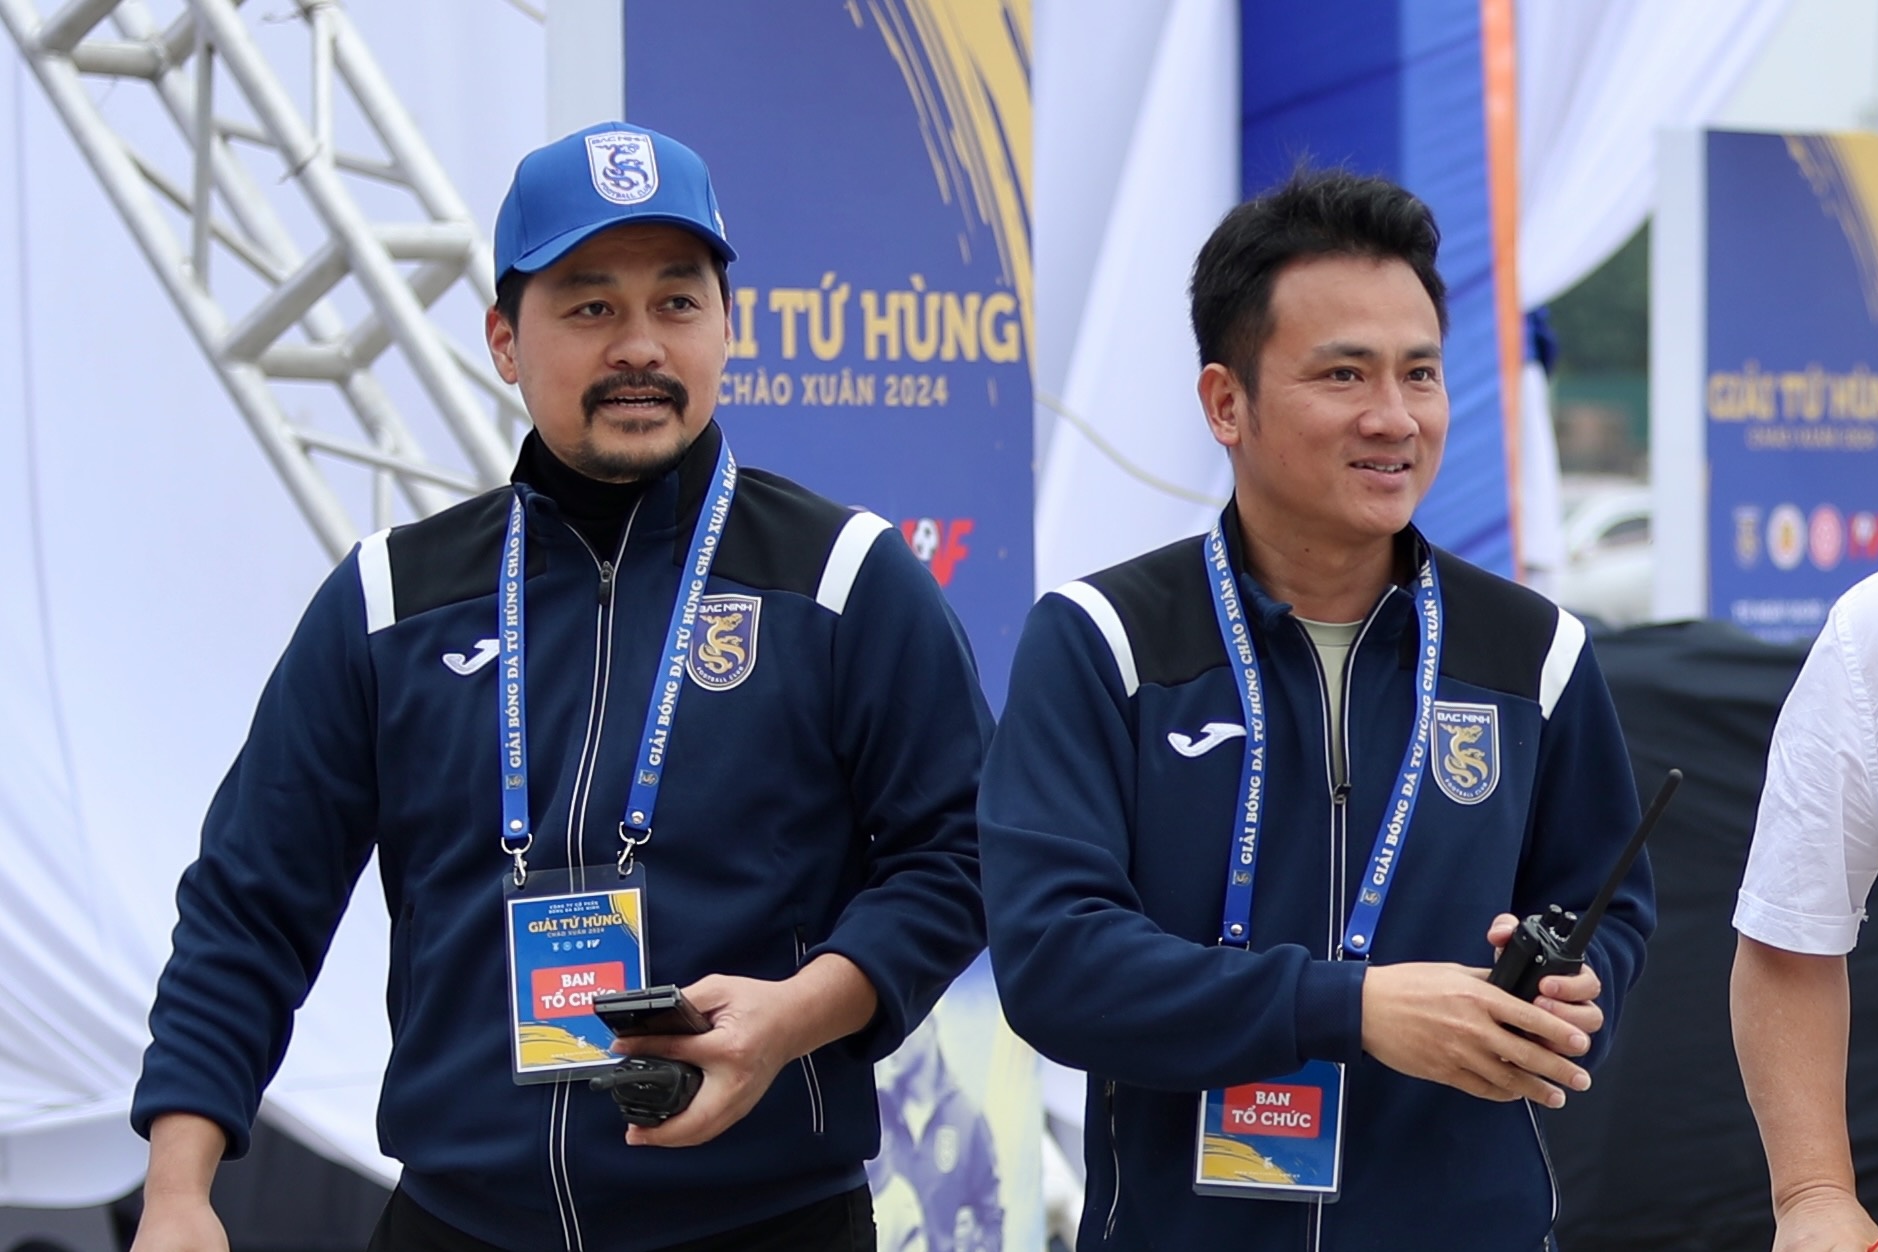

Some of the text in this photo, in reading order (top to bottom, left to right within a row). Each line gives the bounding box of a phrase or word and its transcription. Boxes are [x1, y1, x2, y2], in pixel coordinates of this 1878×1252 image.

[600, 182, 636, 199] FOOTBALL
[769, 271, 851, 360] TỨ
[861, 273, 1020, 363] HÙNG
[717, 367, 948, 407] CHÀO XUÂN 2024
[708, 495, 729, 534] XUÂN
[507, 537, 520, 578] CHÀO
[695, 536, 716, 576] CHÀO
[503, 580, 518, 627] HÙNG
[683, 579, 703, 625] HÙNG
[723, 603, 752, 612] NINH
[1220, 578, 1240, 622] XUÂN
[676, 626, 691, 650] TỨ
[1424, 599, 1439, 643] XUÂN
[504, 629, 518, 653] TỨ
[1232, 623, 1253, 665] CHÀO
[697, 666, 744, 682] FOOTBALL CLUB
[1423, 645, 1436, 691] CHÀO
[505, 682, 520, 728] BÓNG
[657, 680, 678, 726] BÓNG
[1245, 668, 1262, 715] HÙNG
[1251, 717, 1264, 742] TỨ
[1417, 694, 1431, 743] HÙNG
[1462, 713, 1490, 724] NINH
[504, 732, 522, 768] GIẢI
[649, 729, 667, 765] GIẢI
[1410, 742, 1424, 768] TỨ
[1244, 775, 1261, 824] BÓNG
[1386, 799, 1409, 846] BÓNG
[1238, 827, 1256, 864] GIẢI
[1373, 848, 1394, 885] GIẢI
[528, 916, 558, 933] GIẢI
[582, 912, 623, 928] HÙNG
[541, 986, 617, 1009] TỔ CH
[561, 971, 595, 988] BAN
[1232, 1105, 1312, 1128] TỔ CHỨC
[1255, 1090, 1292, 1107] BAN
